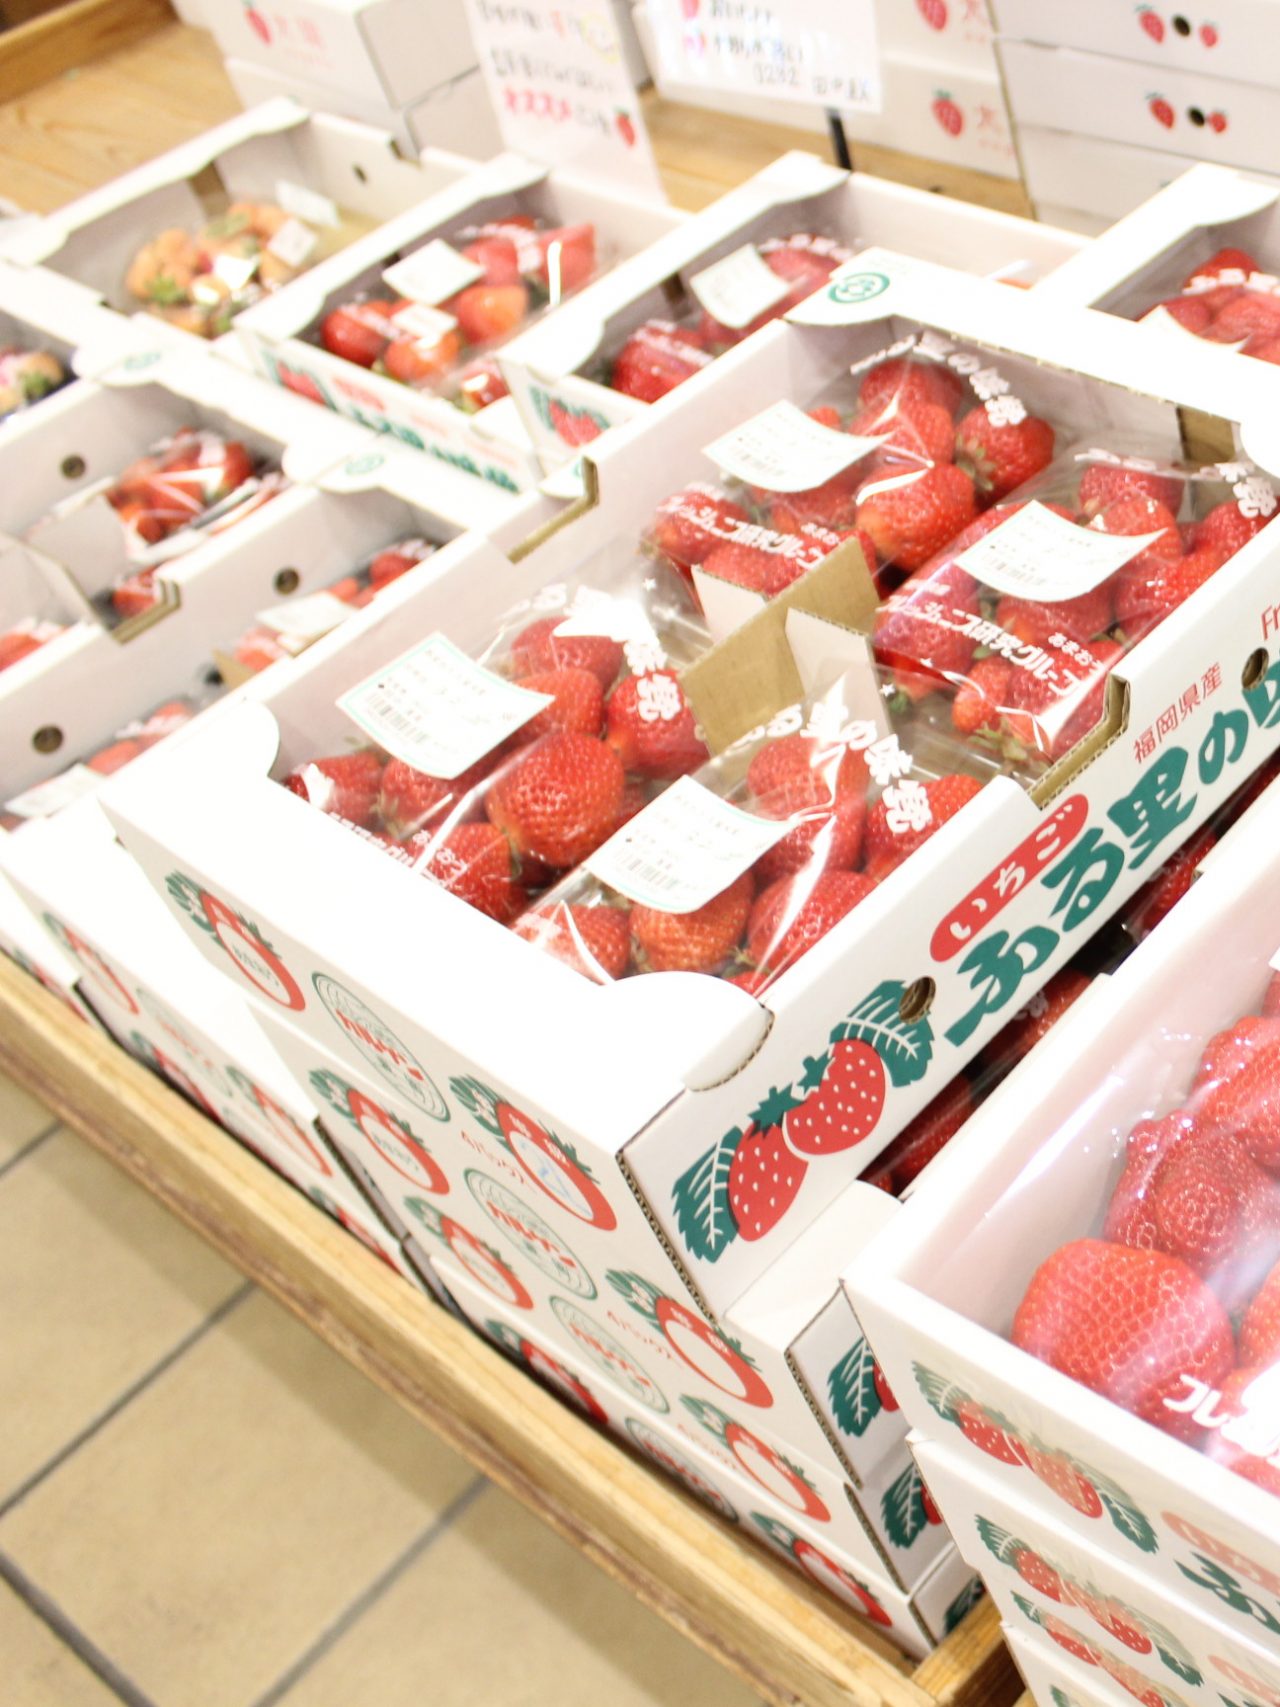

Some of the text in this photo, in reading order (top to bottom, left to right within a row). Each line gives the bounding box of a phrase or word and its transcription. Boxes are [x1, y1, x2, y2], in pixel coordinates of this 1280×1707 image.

[1133, 661, 1224, 764] 福岡県産
[949, 802, 1075, 940] いちご
